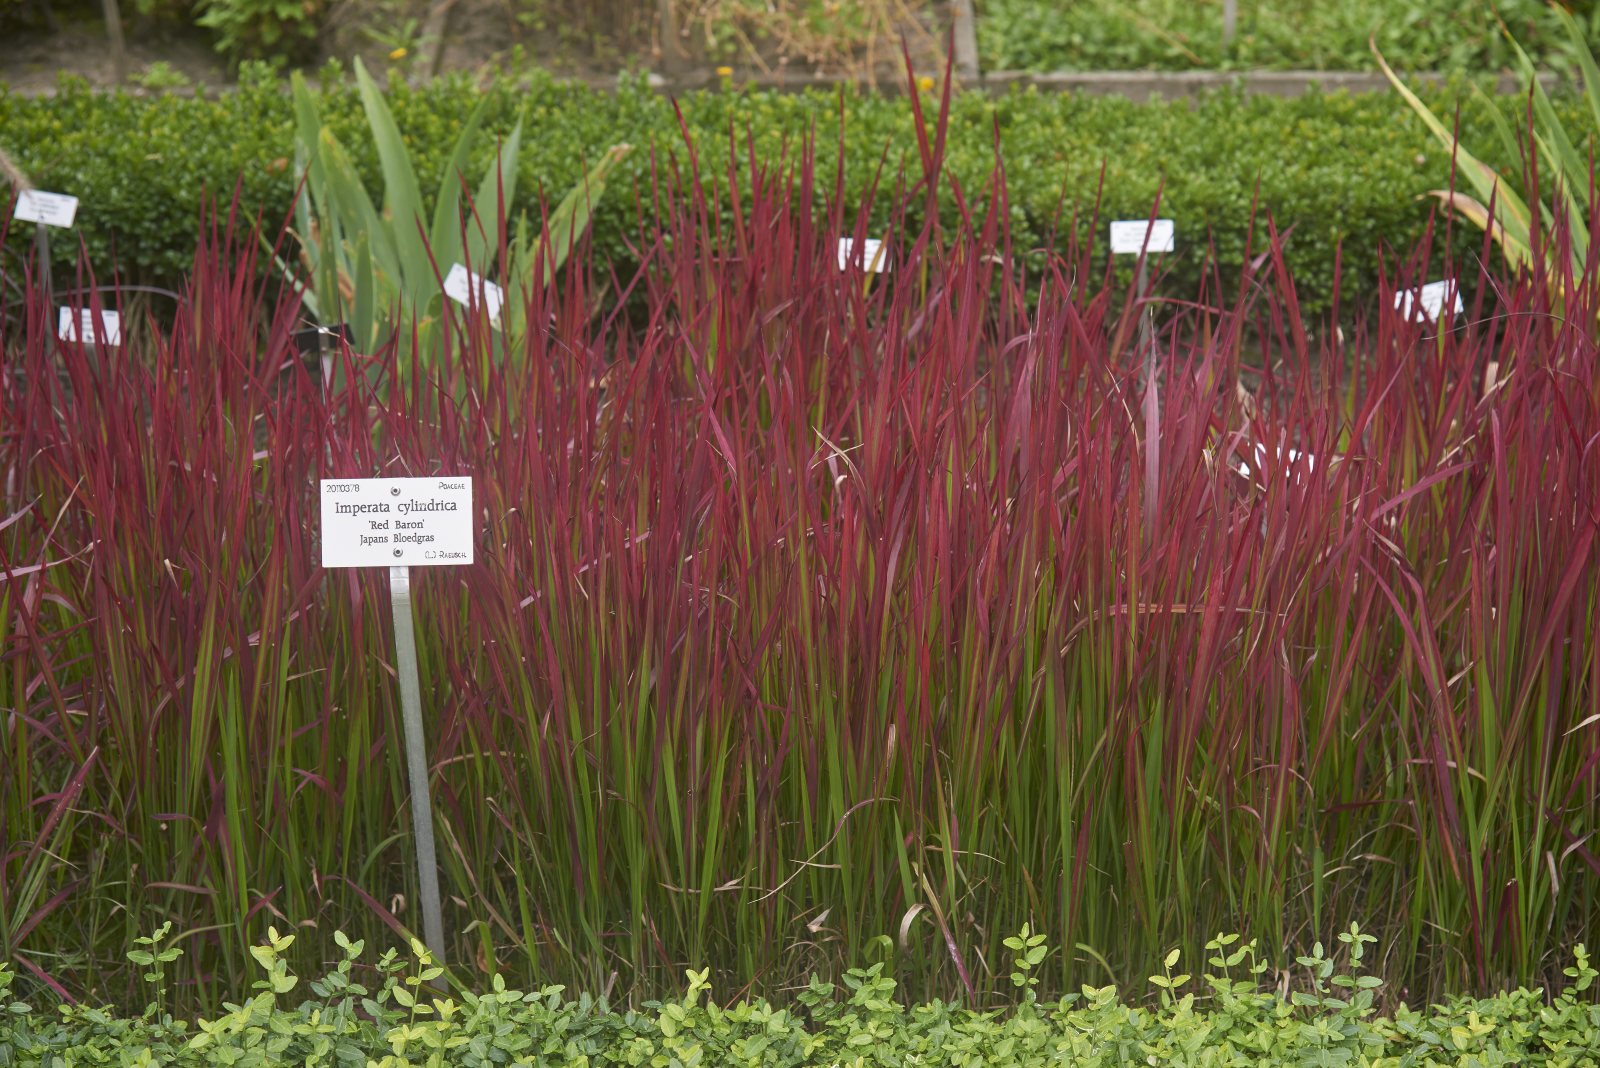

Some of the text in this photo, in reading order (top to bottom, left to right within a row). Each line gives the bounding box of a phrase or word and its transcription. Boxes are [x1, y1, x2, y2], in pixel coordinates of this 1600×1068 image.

[335, 499, 458, 517] Imperata cylindrica
[368, 519, 425, 530] 'Red Baron'
[360, 533, 435, 547] Japans Bloedgras
